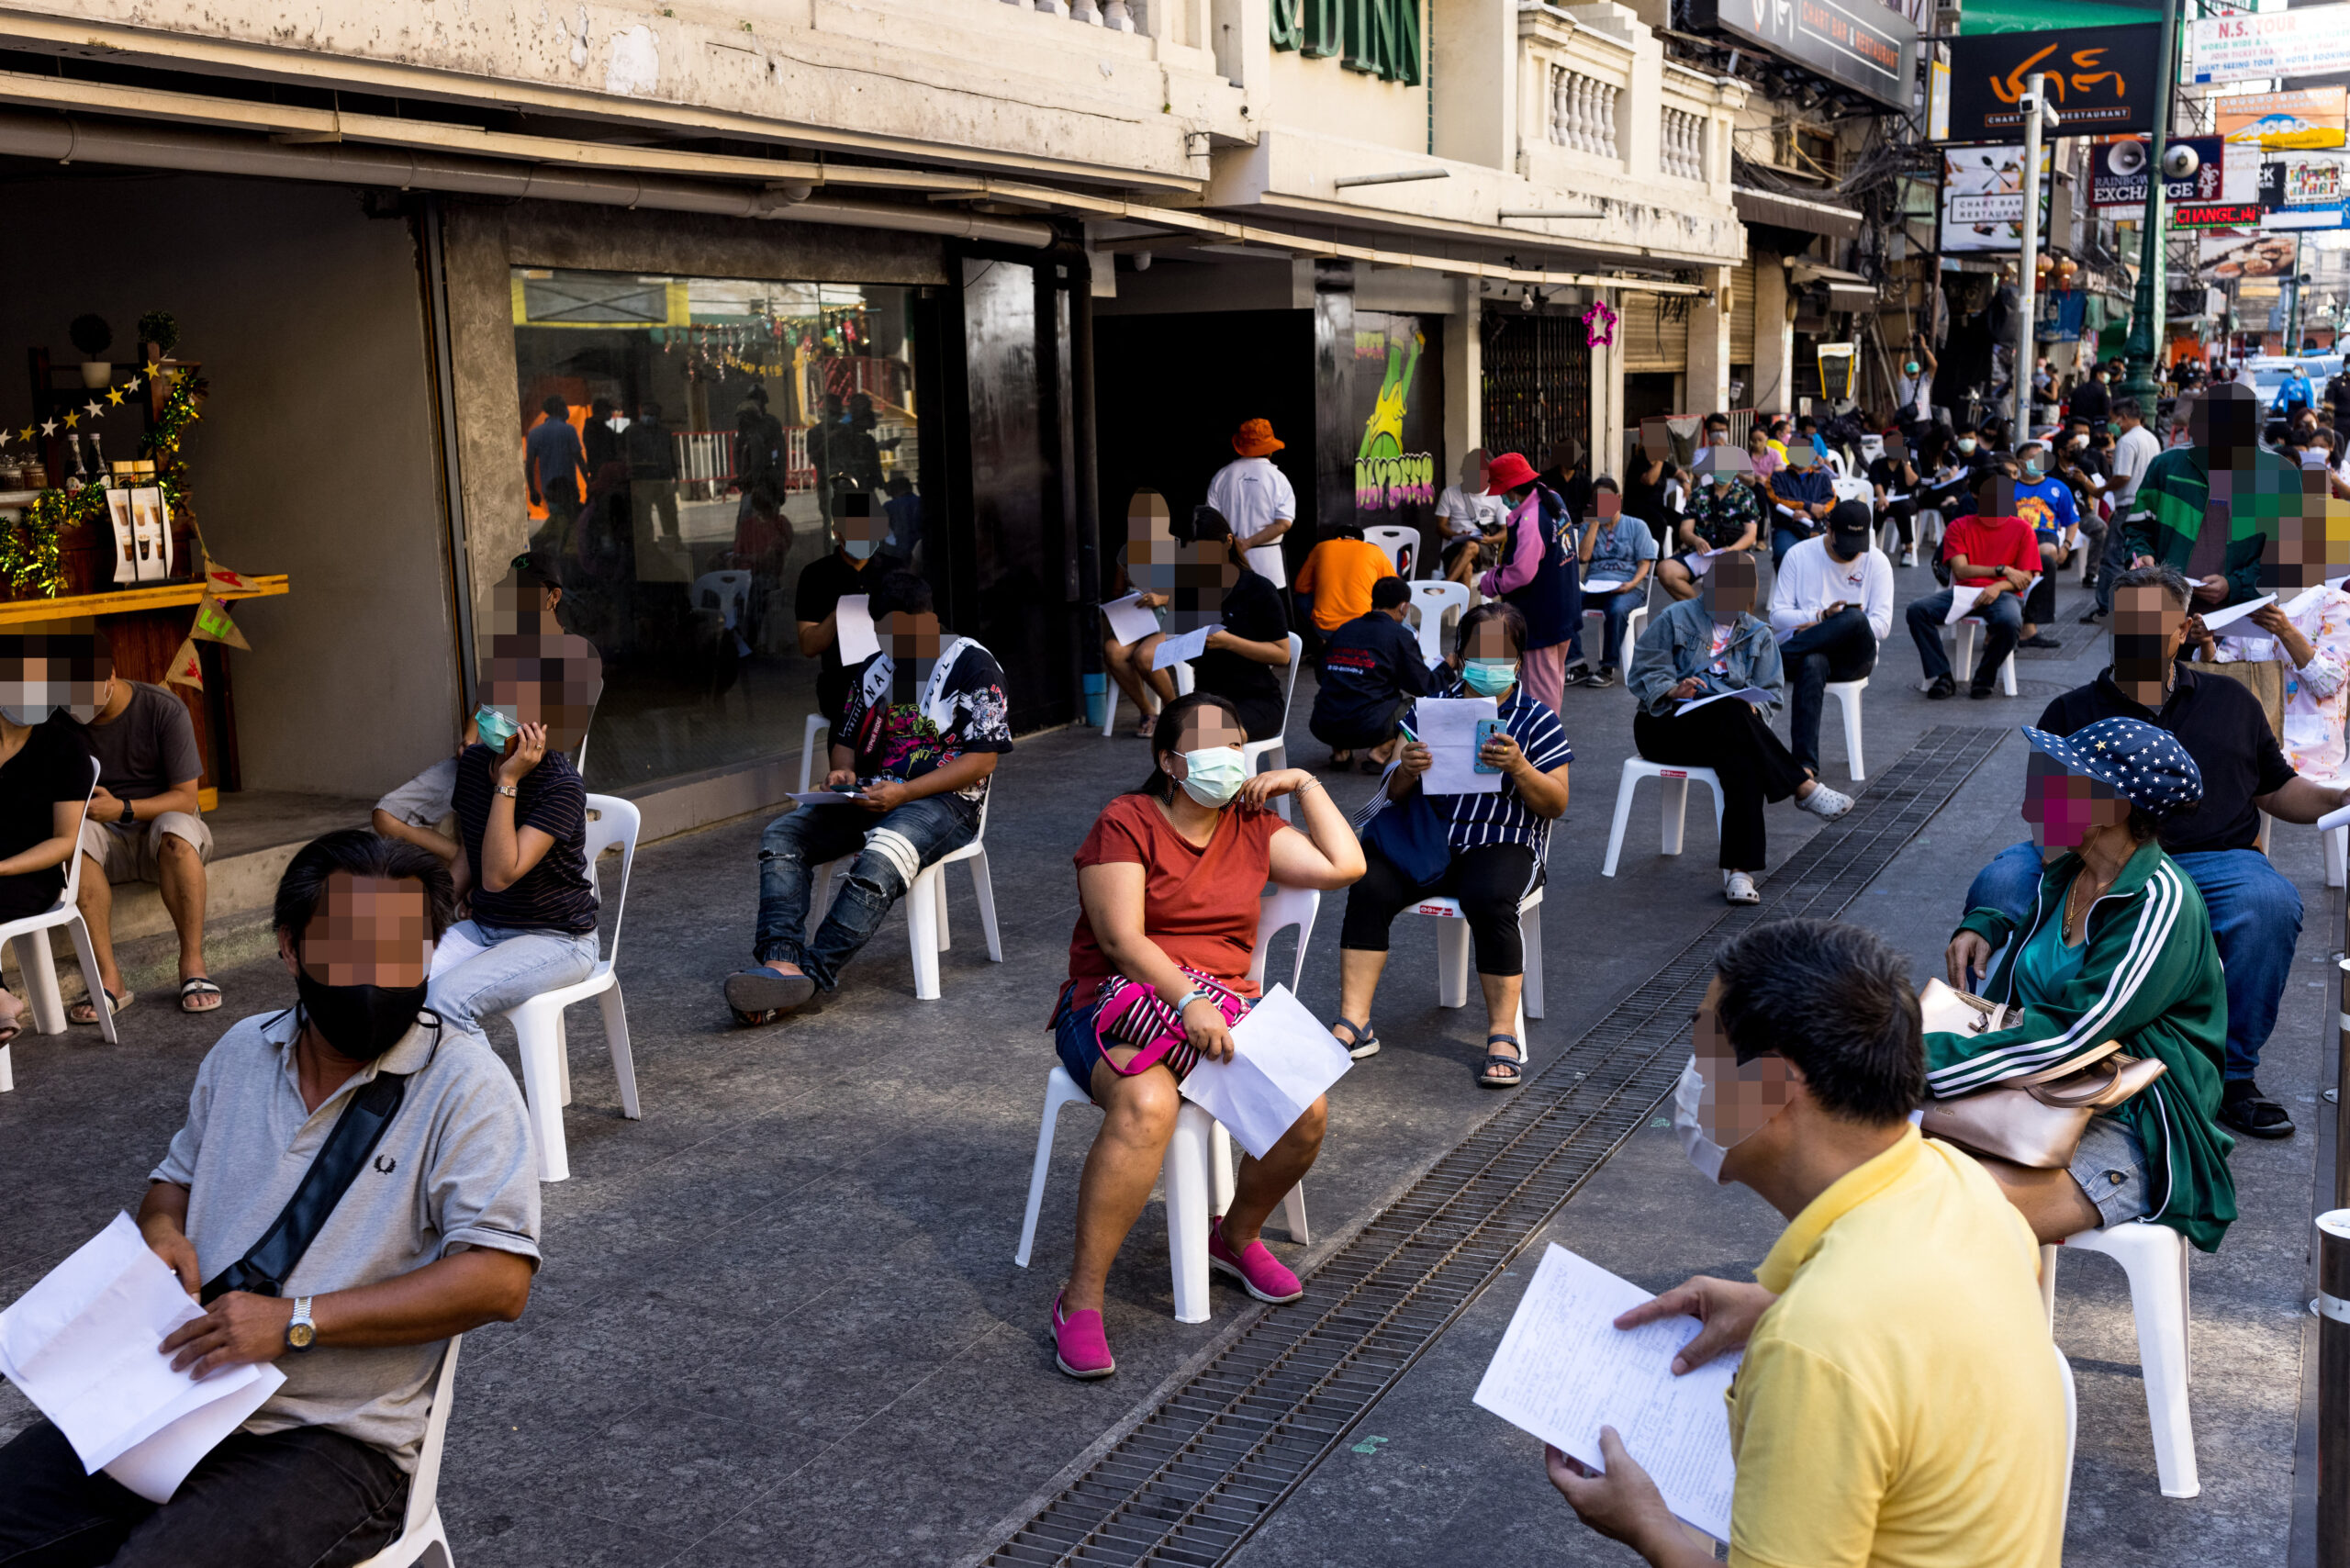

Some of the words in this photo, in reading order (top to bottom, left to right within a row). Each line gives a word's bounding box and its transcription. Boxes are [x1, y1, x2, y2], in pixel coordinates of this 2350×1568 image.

[1802, 1, 1830, 32] CHART
[1831, 17, 1848, 42] BAR
[1855, 29, 1899, 69] RESTAURANT
[2218, 21, 2248, 39] N.S.
[2256, 16, 2297, 35] TOUR
[2200, 40, 2228, 50] WORLD
[2232, 39, 2252, 49] WIDE
[2198, 63, 2220, 73] SIGHT
[2223, 61, 2250, 70] SEEING
[2254, 58, 2274, 67] TOUR
[2286, 54, 2310, 63] HOTEL
[1987, 114, 2020, 125] CHART
[2060, 108, 2127, 120] RESTAURANT
[2095, 174, 2148, 187] RAINBOW
[1960, 200, 1995, 208] CHART
[1960, 209, 2023, 218] RESTAURAN
